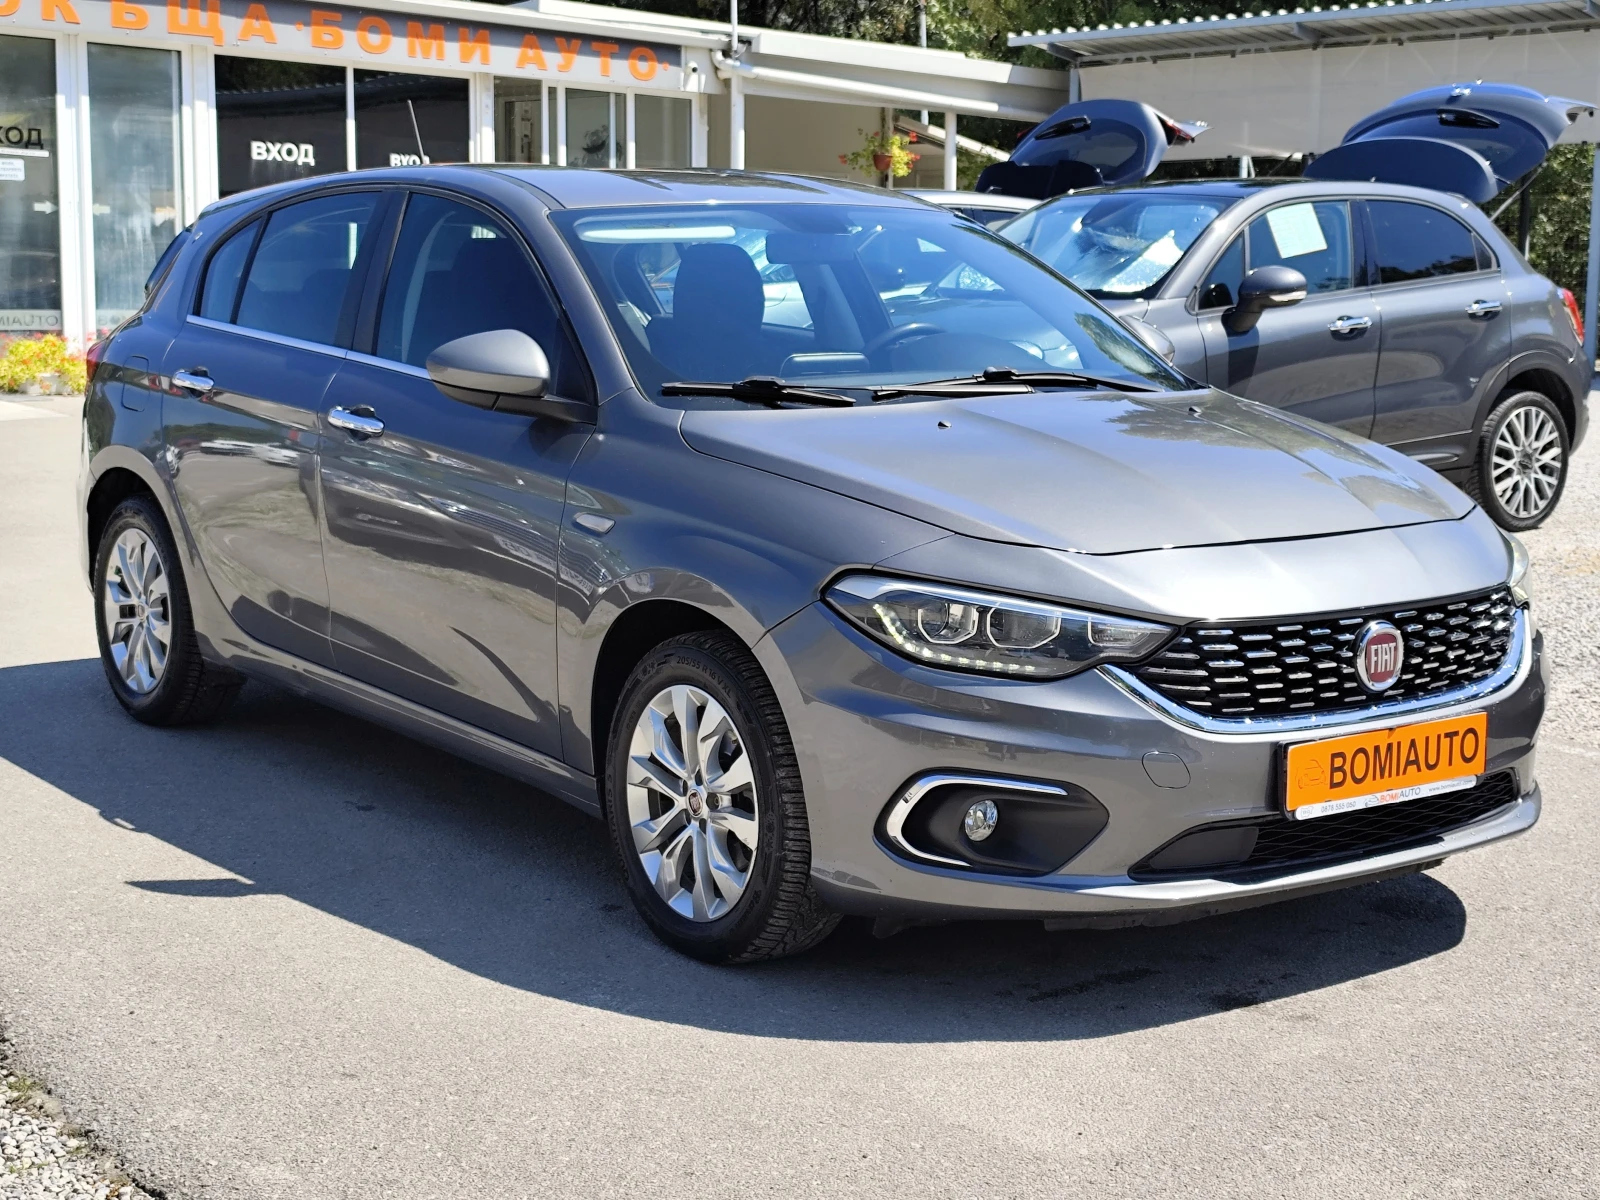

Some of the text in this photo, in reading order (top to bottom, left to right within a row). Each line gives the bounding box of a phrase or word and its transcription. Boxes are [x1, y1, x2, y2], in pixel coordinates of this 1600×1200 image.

[310, 9, 491, 65] БОМИ
[516, 33, 658, 82] АУТО
[250, 140, 315, 166] ВХОД
[676, 655, 701, 669] 205/55
[1370, 642, 1396, 674] FIAT
[1329, 727, 1480, 790] BOMIAUTO
[1379, 786, 1421, 804] BOMIAUTO
